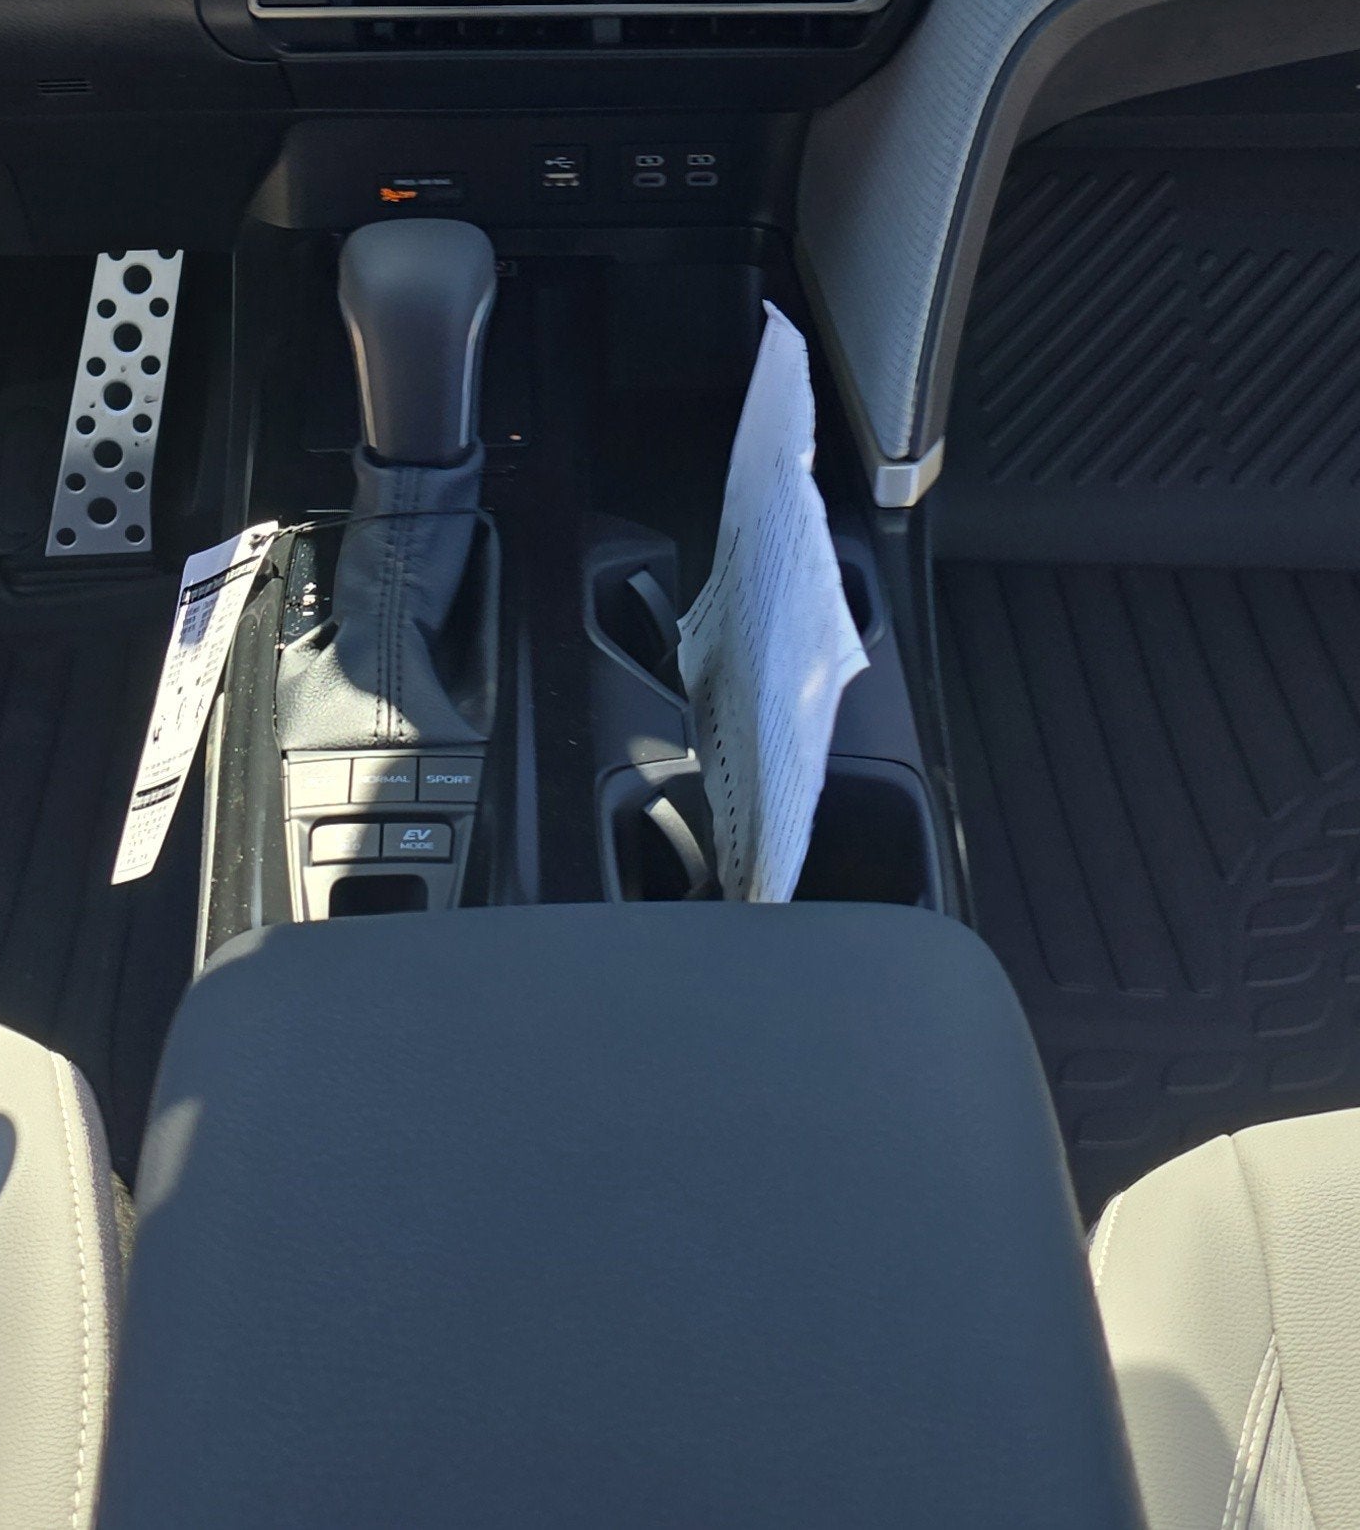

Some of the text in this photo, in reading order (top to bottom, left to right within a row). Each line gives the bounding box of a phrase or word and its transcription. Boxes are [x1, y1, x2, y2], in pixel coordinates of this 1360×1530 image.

[360, 774, 411, 785] ORMAL
[425, 774, 474, 785] SPORT
[402, 828, 433, 841] EV
[399, 841, 435, 851] MODE
